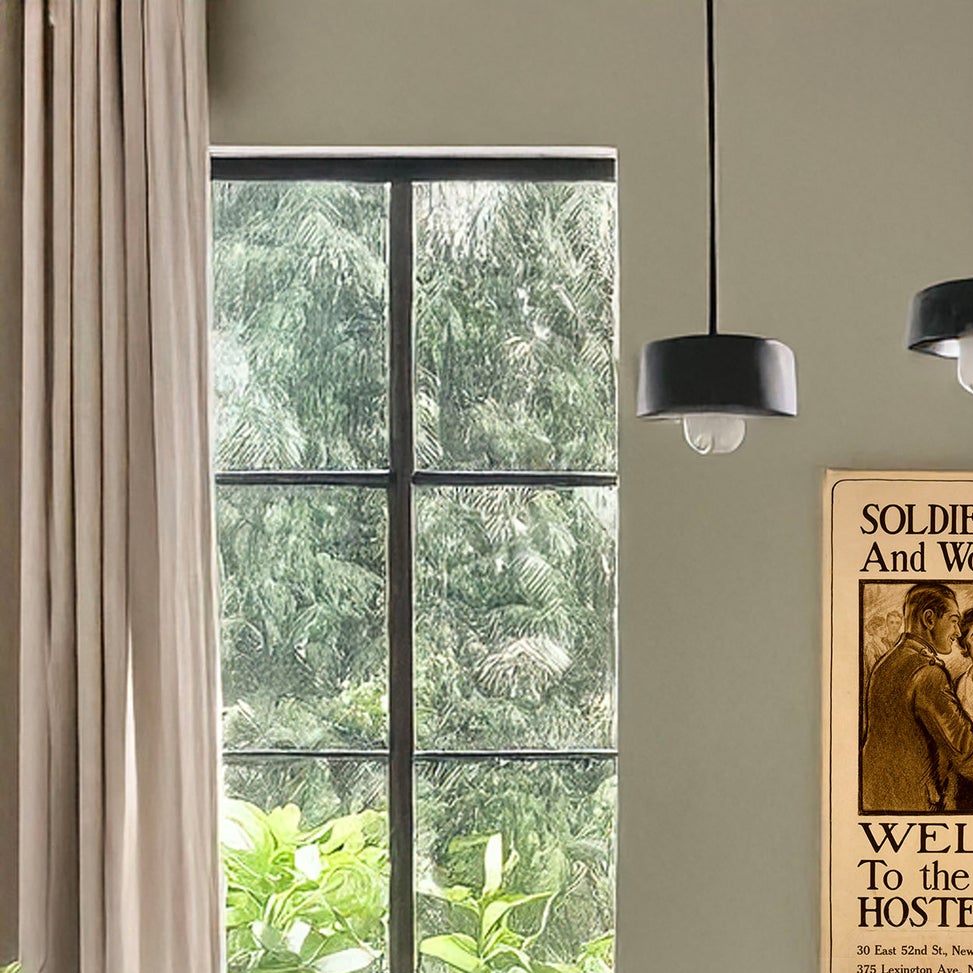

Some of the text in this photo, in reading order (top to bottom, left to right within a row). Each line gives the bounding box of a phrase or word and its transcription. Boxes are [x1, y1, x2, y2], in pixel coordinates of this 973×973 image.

[860, 542, 927, 572] And
[858, 860, 904, 890] To
[920, 860, 970, 891] the
[857, 945, 871, 956] 30
[874, 945, 897, 956] East
[901, 945, 928, 956] 52nd
[931, 945, 948, 957] St.,
